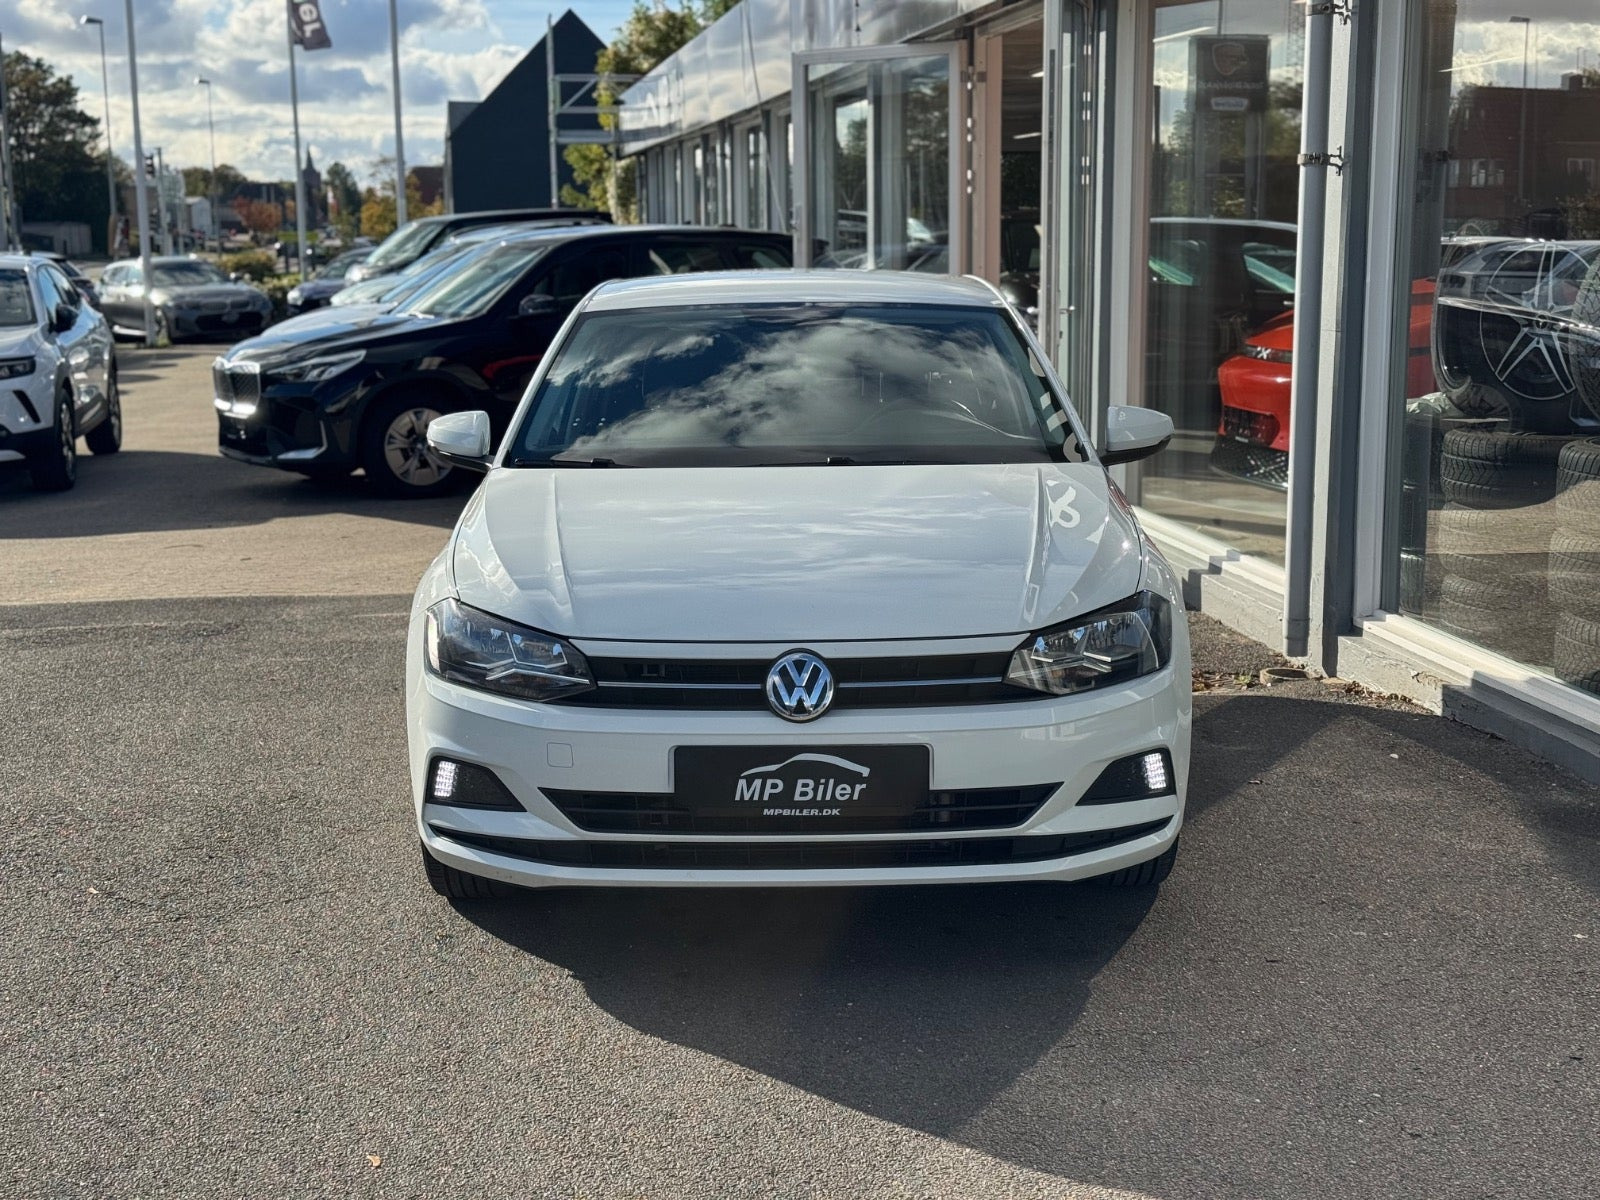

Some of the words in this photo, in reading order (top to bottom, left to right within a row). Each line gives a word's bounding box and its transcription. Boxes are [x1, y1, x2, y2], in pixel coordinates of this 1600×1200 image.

[734, 778, 784, 801] MP
[793, 778, 867, 801] Biler
[762, 808, 841, 816] MPBILER.DK
